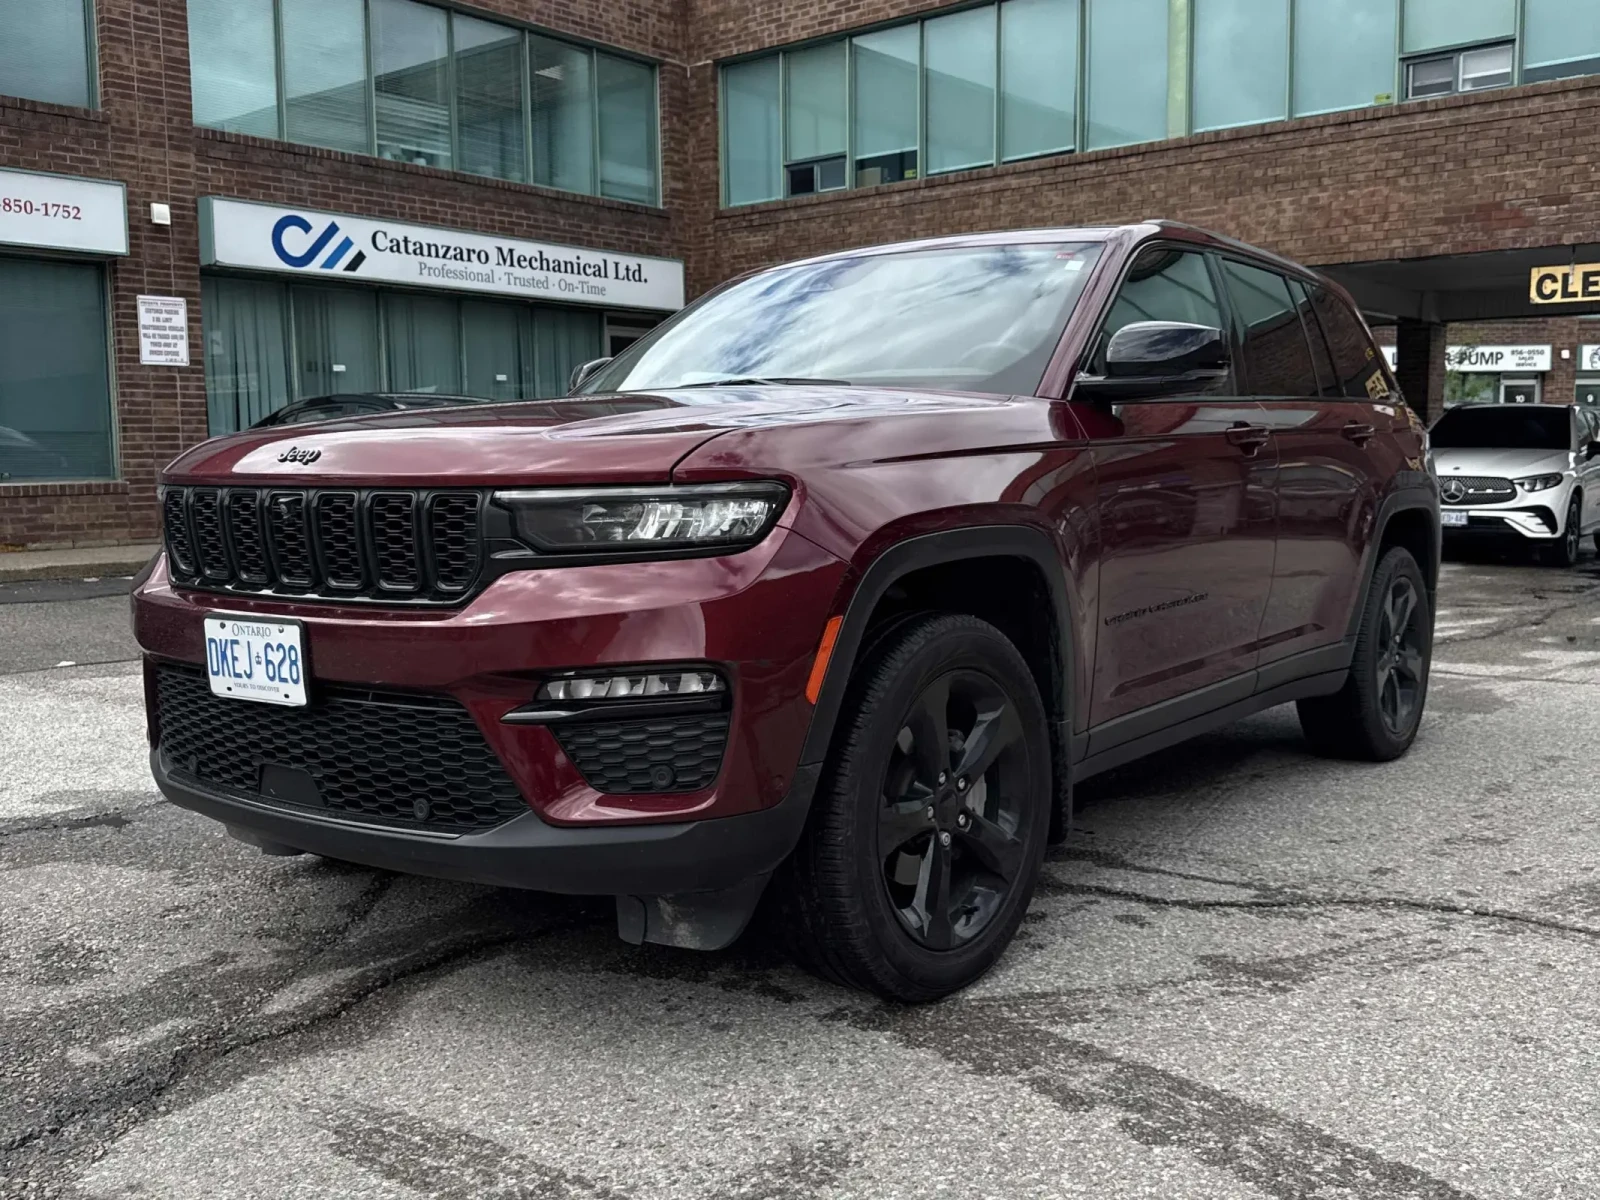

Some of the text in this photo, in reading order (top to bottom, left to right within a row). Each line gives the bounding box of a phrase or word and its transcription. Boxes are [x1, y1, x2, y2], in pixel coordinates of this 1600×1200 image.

[0, 197, 82, 221] 850-1752
[371, 230, 649, 284] Catanzaro Mechanical Ltd.
[418, 262, 607, 297] Professional Trusted On-Time
[1536, 271, 1600, 300] CLE
[1515, 394, 1526, 403] 10
[1587, 393, 1595, 403] 9
[277, 446, 322, 466] Jeep
[231, 623, 272, 639] ONTARIO
[207, 637, 300, 685] DKEJ 628
